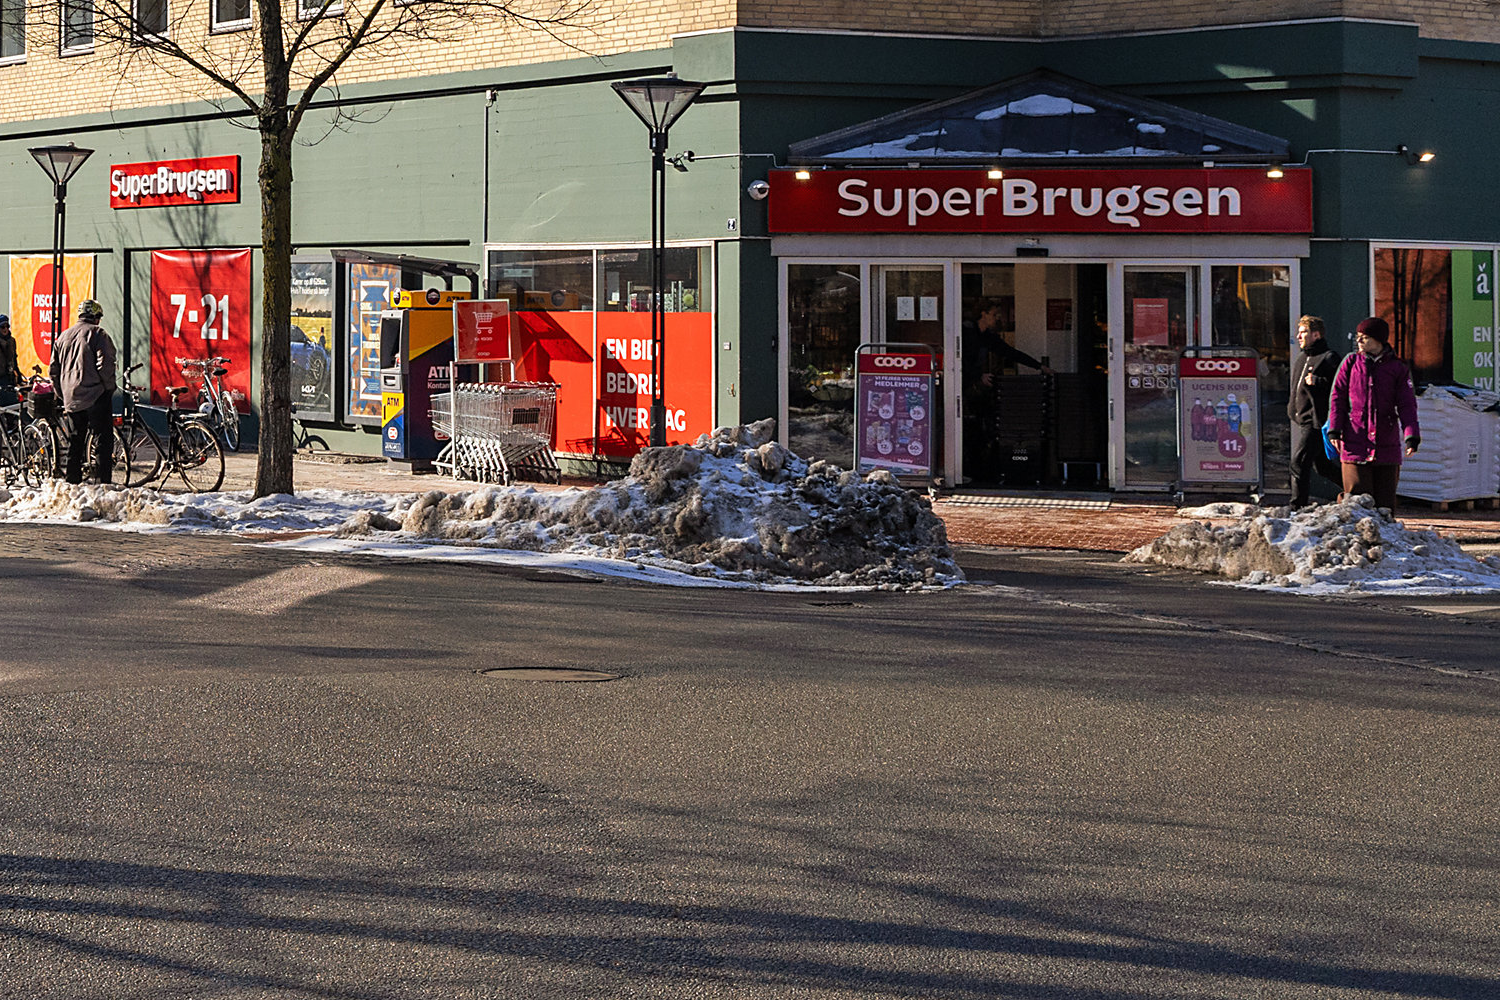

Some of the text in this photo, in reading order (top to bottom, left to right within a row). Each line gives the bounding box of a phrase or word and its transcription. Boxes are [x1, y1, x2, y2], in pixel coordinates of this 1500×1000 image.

[111, 166, 228, 203] SuperBrugsen
[837, 178, 1242, 228] SuperBrugsen
[1473, 327, 1492, 342] EN
[606, 338, 659, 361] EN BID
[874, 356, 917, 369] coop
[1195, 360, 1241, 373] coop
[428, 366, 459, 379] ATM
[606, 372, 661, 395] BEDRE
[1192, 383, 1249, 391] UGENS KØB
[387, 397, 399, 407] ATM
[606, 406, 687, 431] HVER AG
